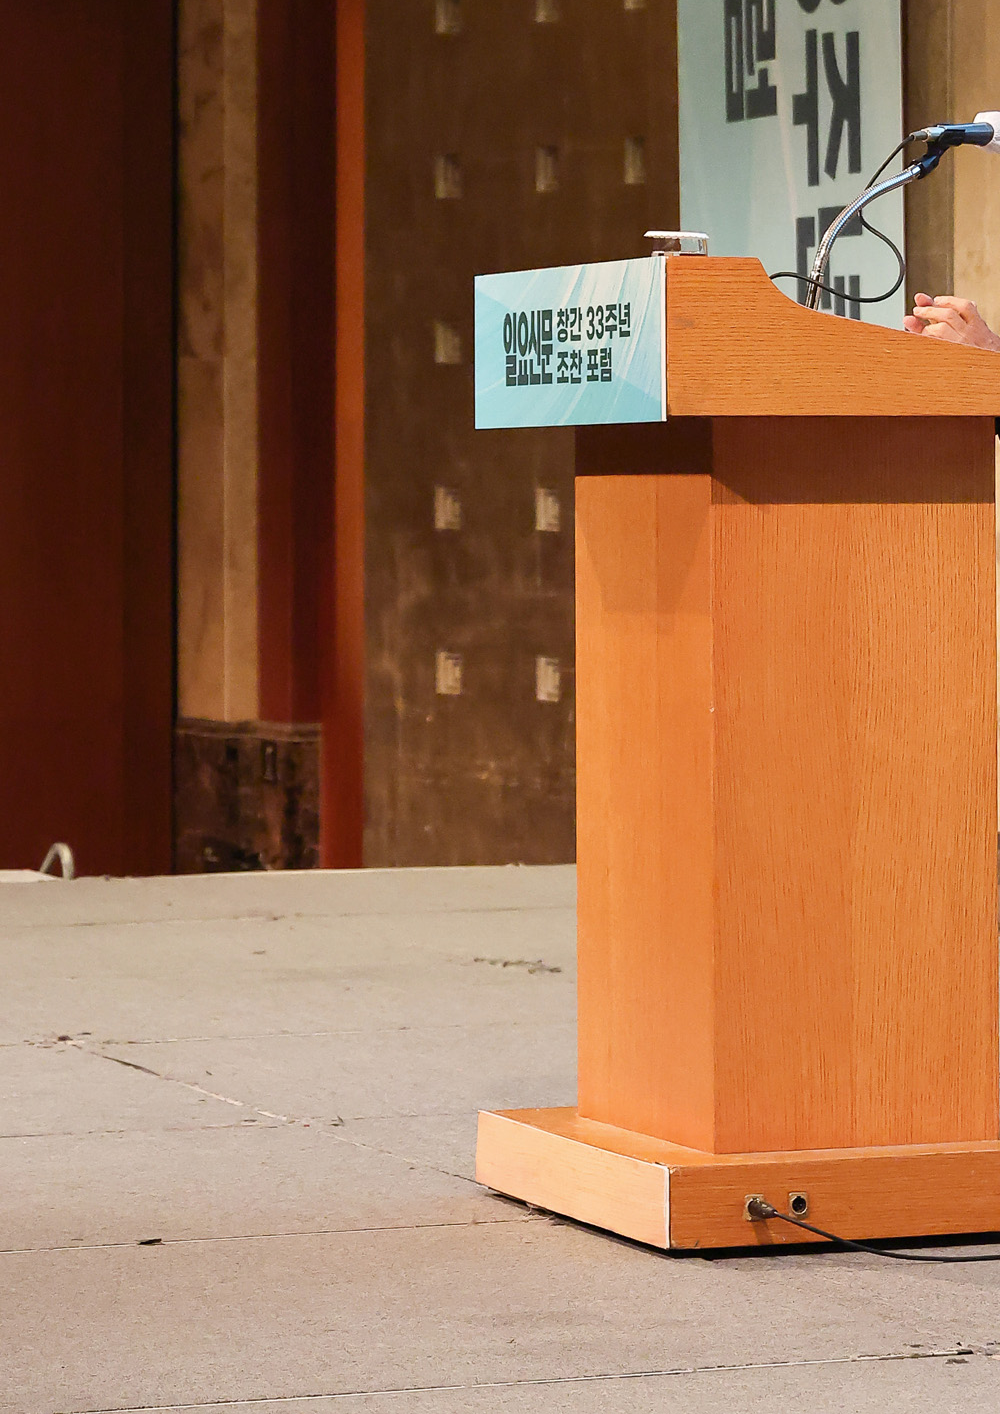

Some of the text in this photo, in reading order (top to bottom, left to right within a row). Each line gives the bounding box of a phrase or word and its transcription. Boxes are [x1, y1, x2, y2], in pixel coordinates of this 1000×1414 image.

[556, 302, 631, 343] 창간 33주년
[503, 309, 553, 387] 일요신문
[556, 347, 613, 384] 조찬 포럼
